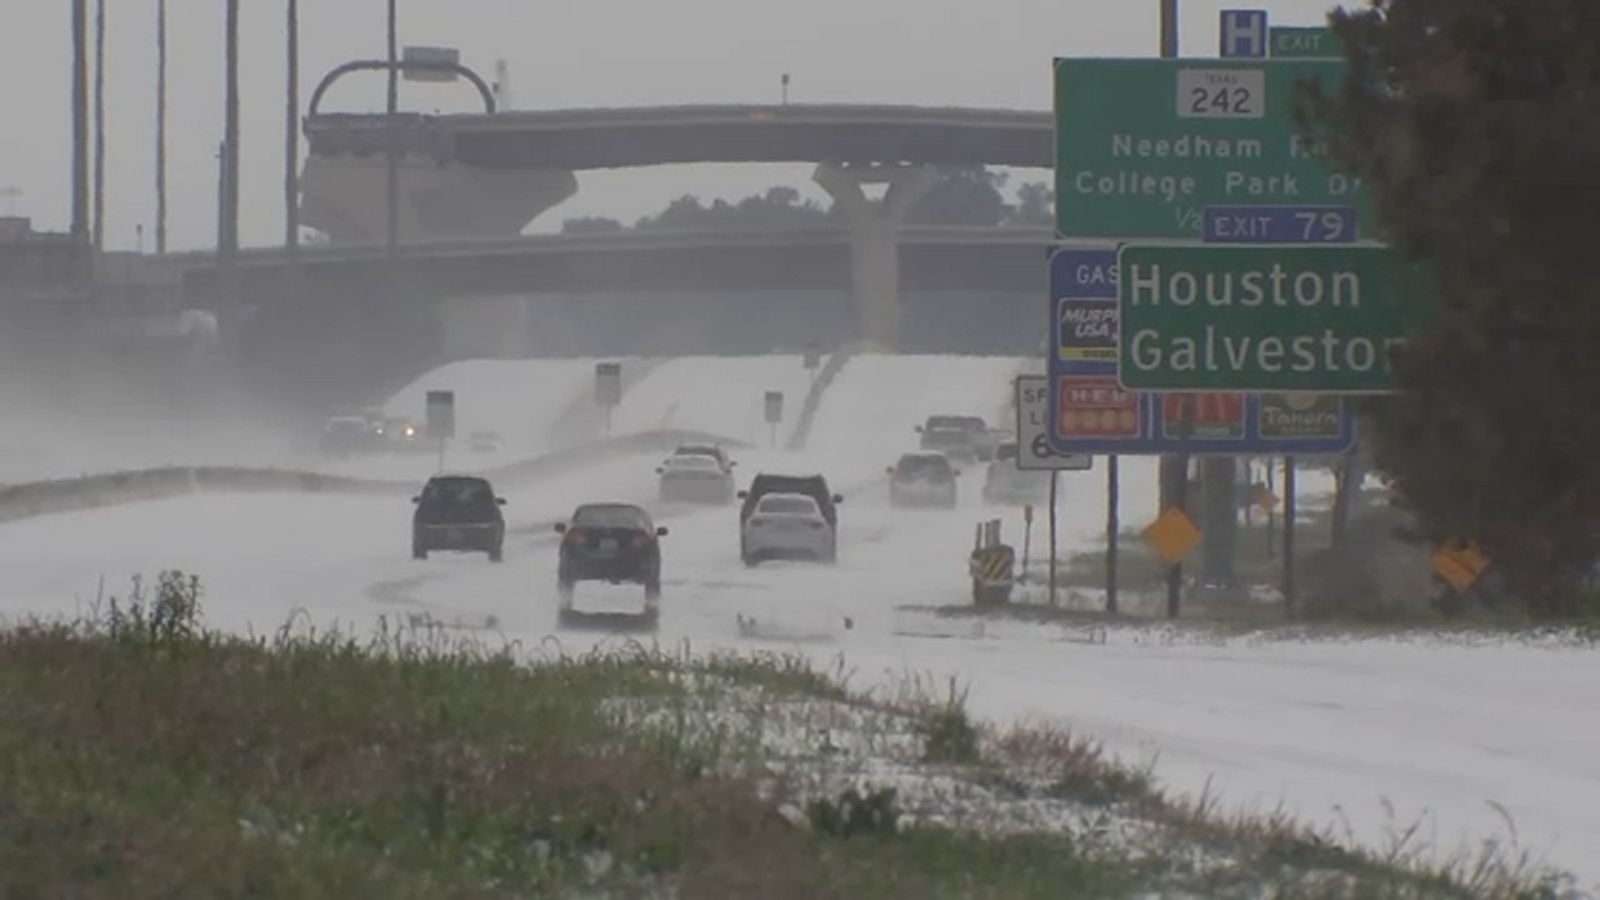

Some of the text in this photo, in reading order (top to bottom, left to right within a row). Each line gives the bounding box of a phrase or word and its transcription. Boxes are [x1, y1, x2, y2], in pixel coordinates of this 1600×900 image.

[1225, 13, 1261, 56] H
[1279, 35, 1321, 52] EXIT
[1191, 86, 1252, 114] 242
[1112, 134, 1262, 157] Needham
[1075, 172, 1197, 201] College
[1225, 172, 1298, 195] Park
[1214, 212, 1344, 240] EXIT 79
[1130, 263, 1360, 307] Houston
[1074, 322, 1109, 338] USA
